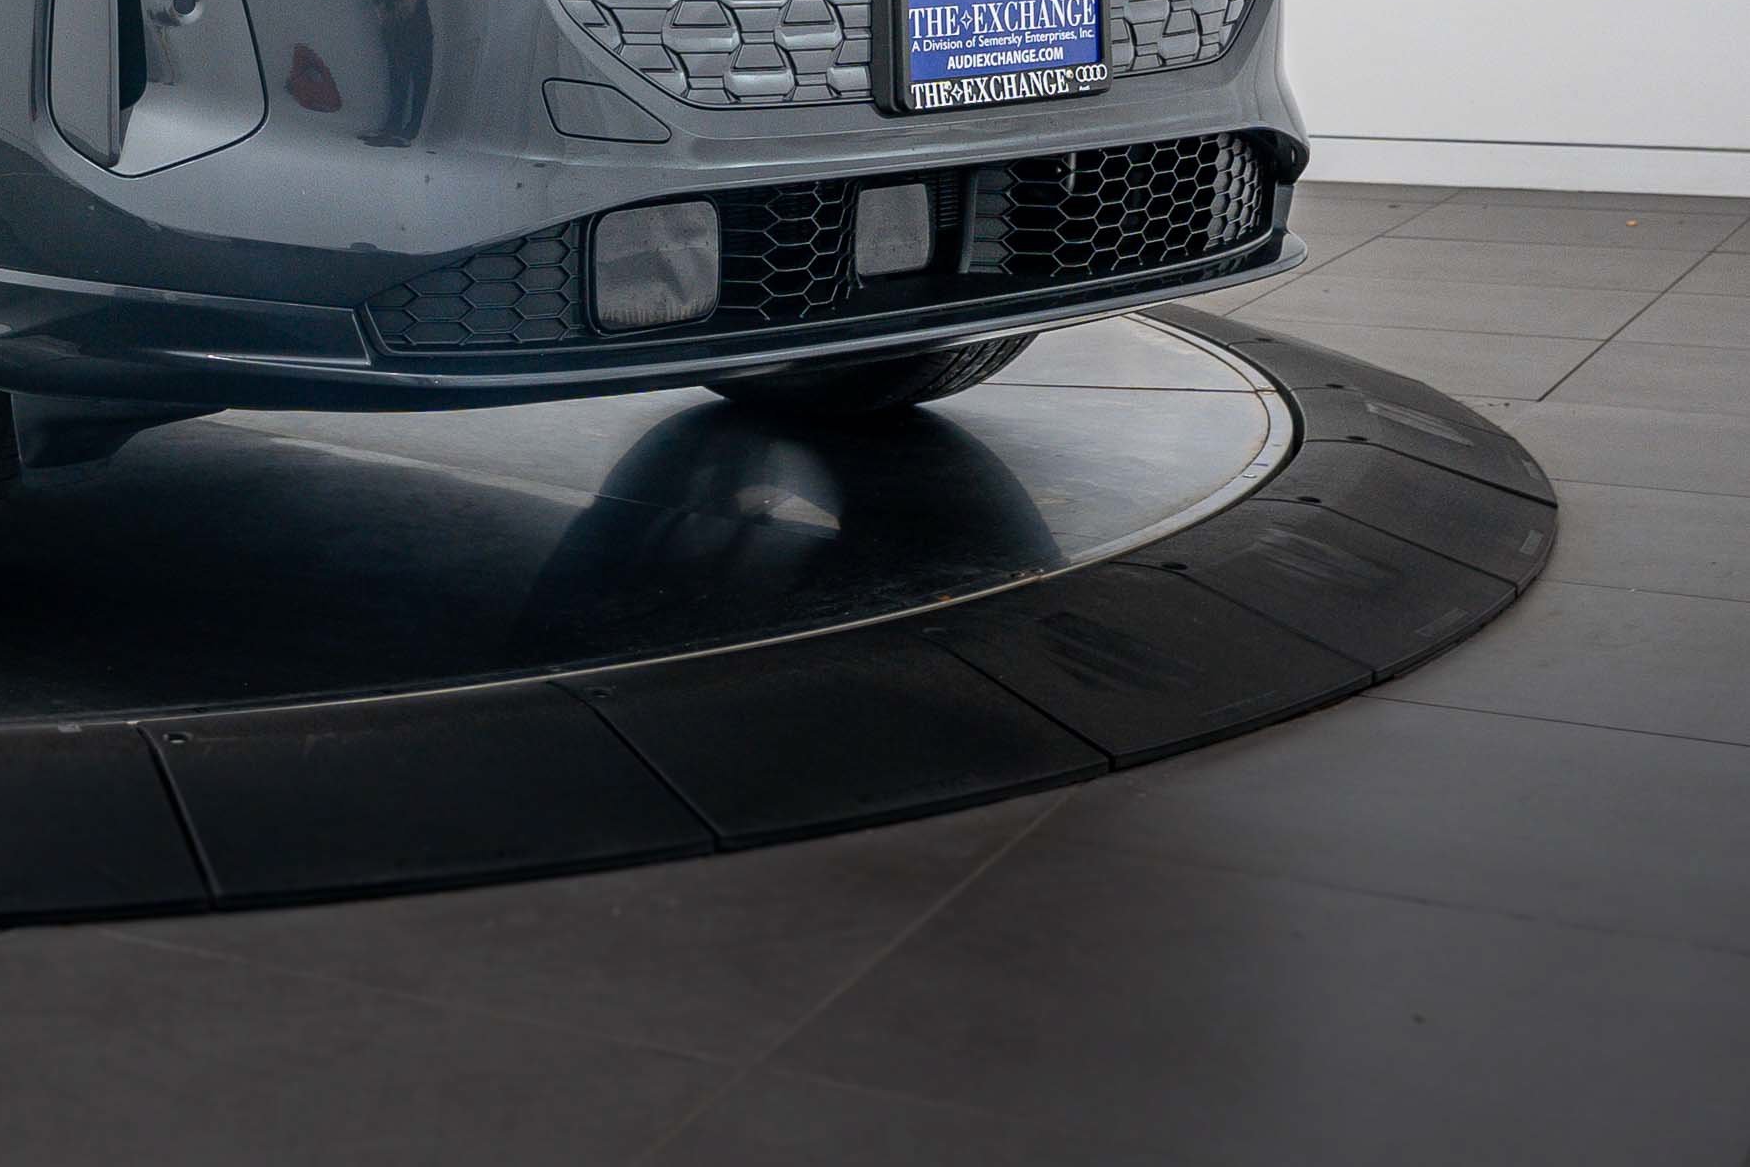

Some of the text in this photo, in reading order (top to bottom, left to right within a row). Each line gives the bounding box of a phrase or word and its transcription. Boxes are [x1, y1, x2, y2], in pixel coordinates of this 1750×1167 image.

[909, 4, 960, 39] THE
[911, 28, 1094, 52] A Division of Semersky Enterprises, Inc.
[947, 47, 1064, 70] AUDIEXCHANGE.COM
[910, 71, 1068, 109] THE EXCHANGE
